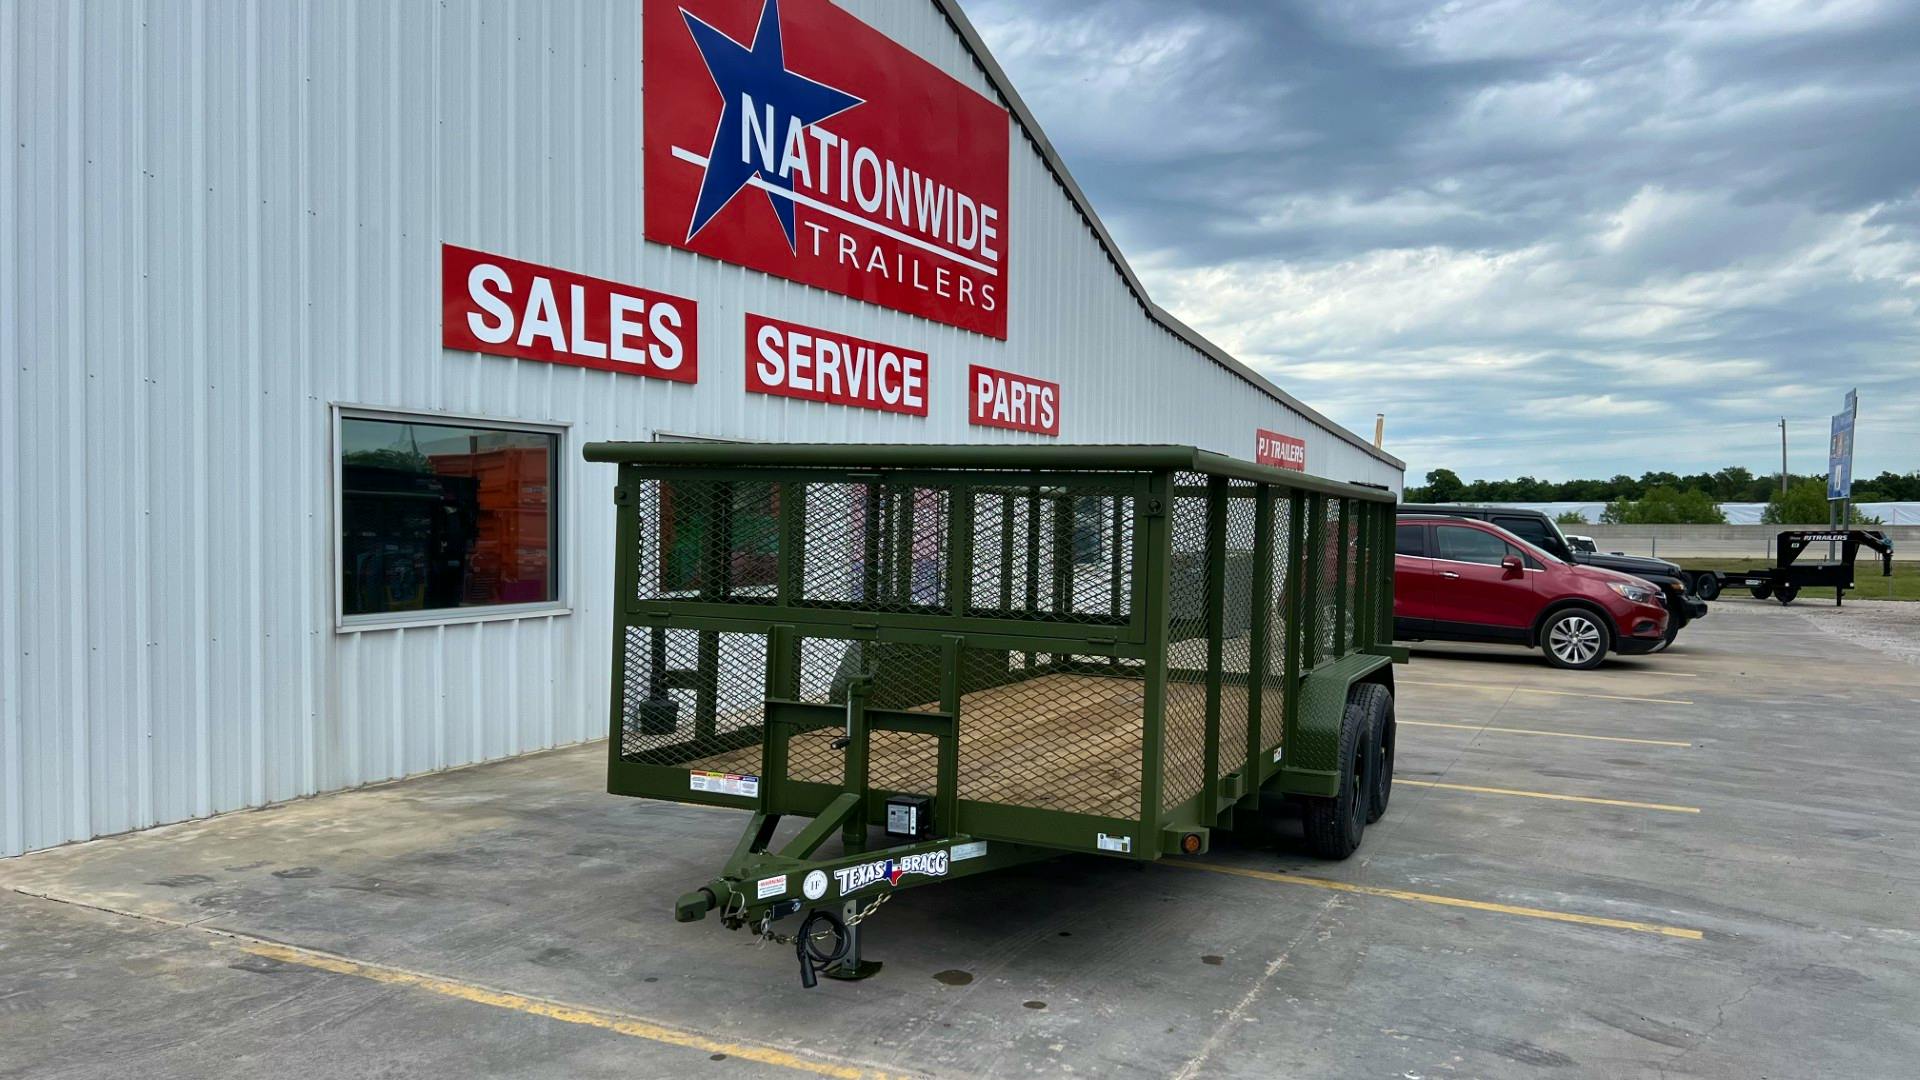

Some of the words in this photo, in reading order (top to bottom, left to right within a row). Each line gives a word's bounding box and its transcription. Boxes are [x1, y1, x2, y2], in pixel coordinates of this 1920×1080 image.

[741, 91, 998, 262] NATIONWIDE
[804, 220, 996, 312] TRAILERS
[466, 263, 684, 371] SALES
[756, 325, 923, 408] SERVICE
[977, 372, 1054, 429] PARTS
[1258, 437, 1270, 457] PJ
[1270, 440, 1304, 463] TRAILERS
[834, 861, 886, 896] TEXAS
[900, 850, 949, 876] BRAGG
